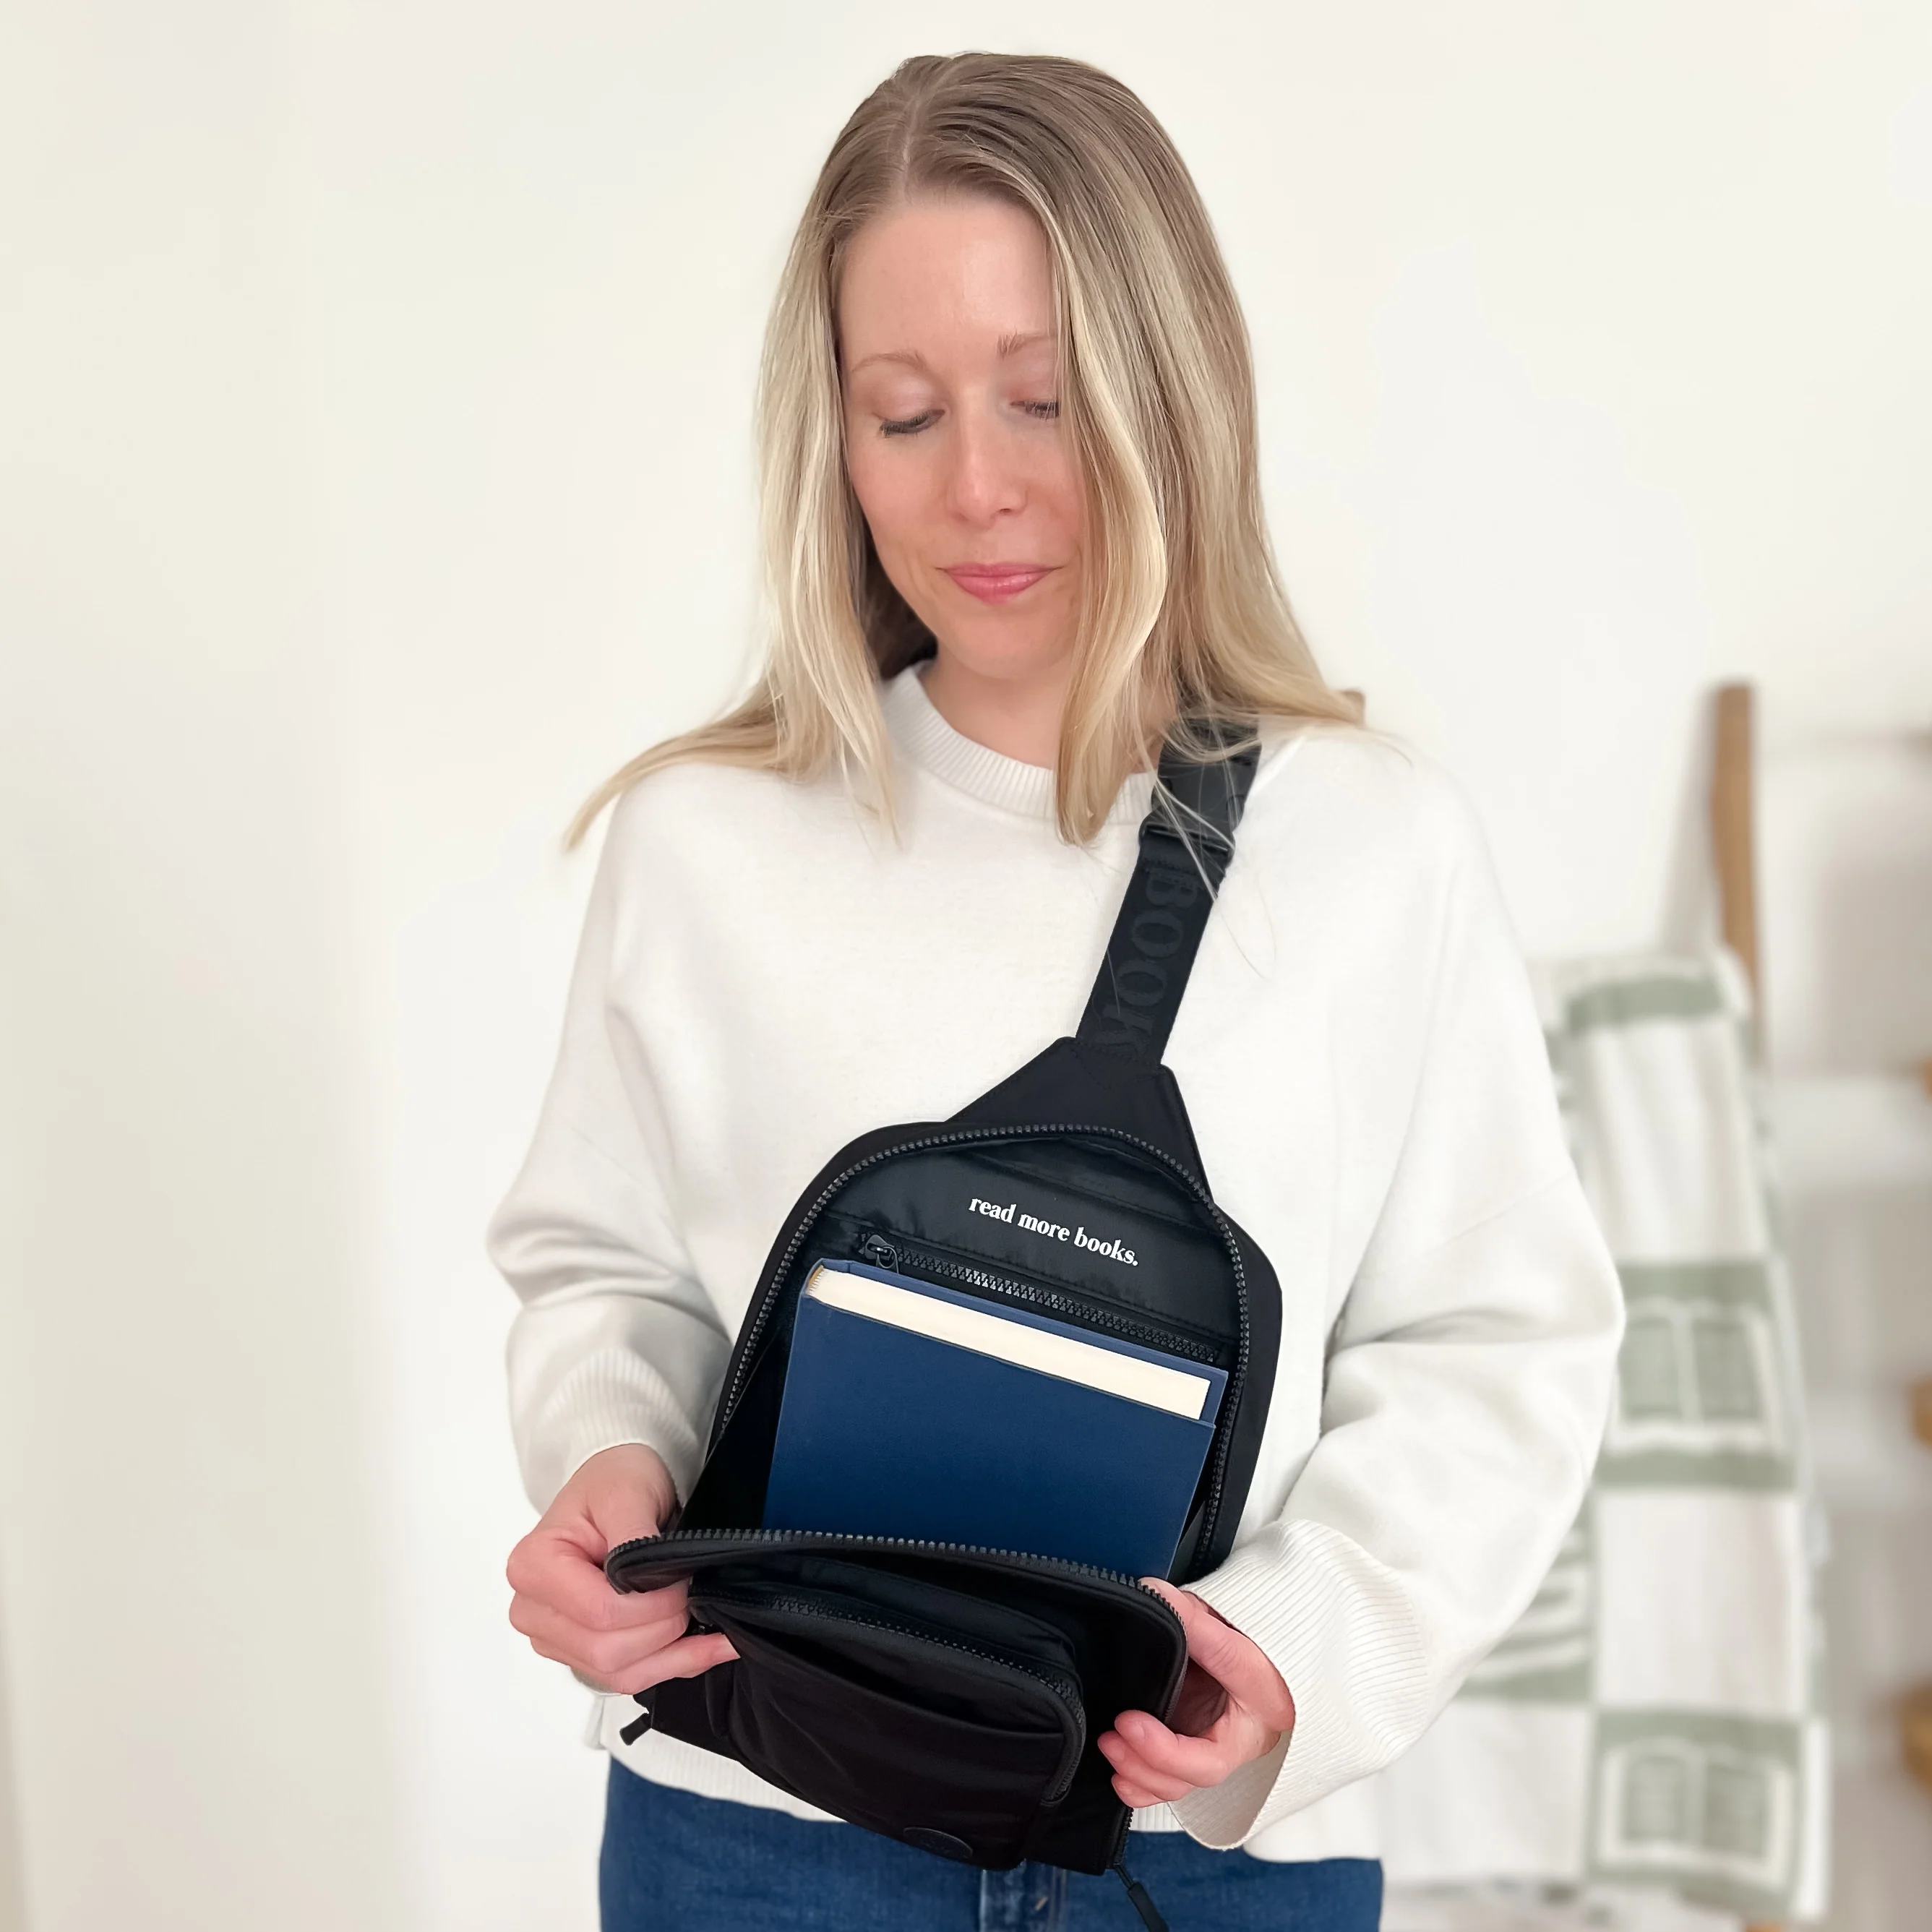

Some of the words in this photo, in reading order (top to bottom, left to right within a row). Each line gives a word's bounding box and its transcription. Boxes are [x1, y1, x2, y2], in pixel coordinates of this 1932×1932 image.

[969, 1198, 1016, 1223] read
[1018, 1214, 1070, 1241] more
[1074, 1227, 1138, 1266] books.
